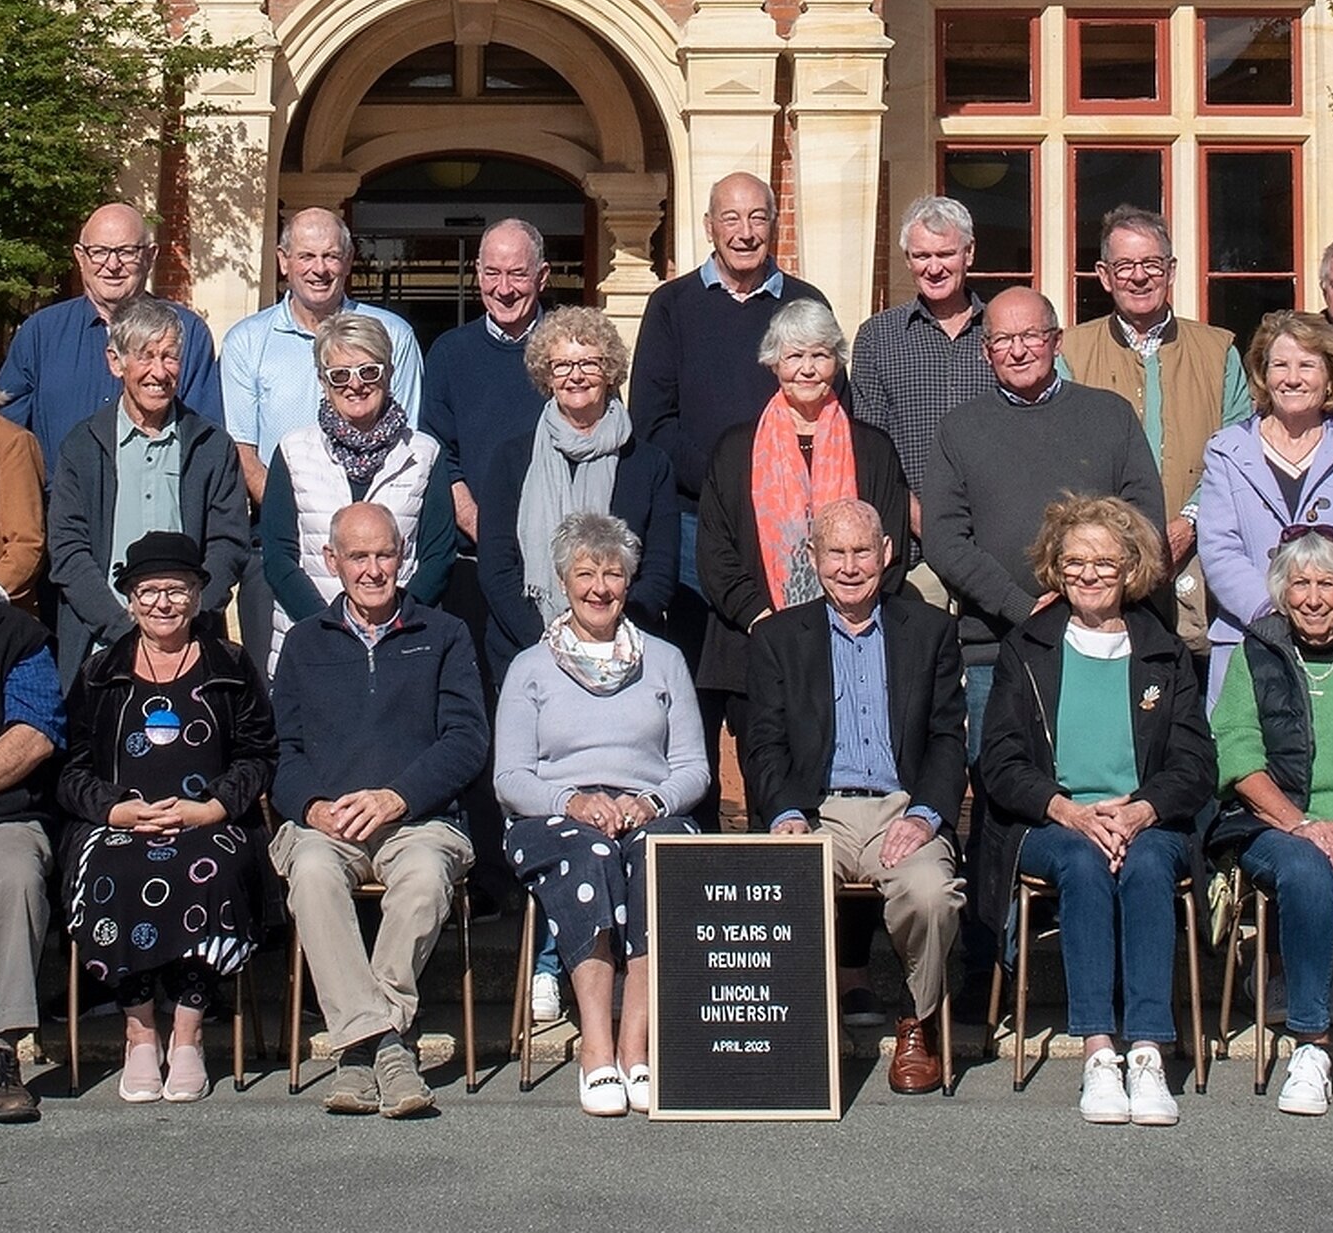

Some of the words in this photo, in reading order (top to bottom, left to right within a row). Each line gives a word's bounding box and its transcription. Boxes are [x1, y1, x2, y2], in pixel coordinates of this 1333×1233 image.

[704, 884, 738, 902] VFM
[745, 884, 782, 902] 1973
[696, 924, 716, 942] 50
[722, 924, 768, 942] YEARS
[772, 924, 792, 942] ON
[708, 951, 772, 969] REUNION
[711, 985, 770, 1002] LINCOLN
[700, 1005, 789, 1023] UNIVERSITY
[711, 1040, 744, 1053] APRIL
[744, 1040, 771, 1053] 2023
